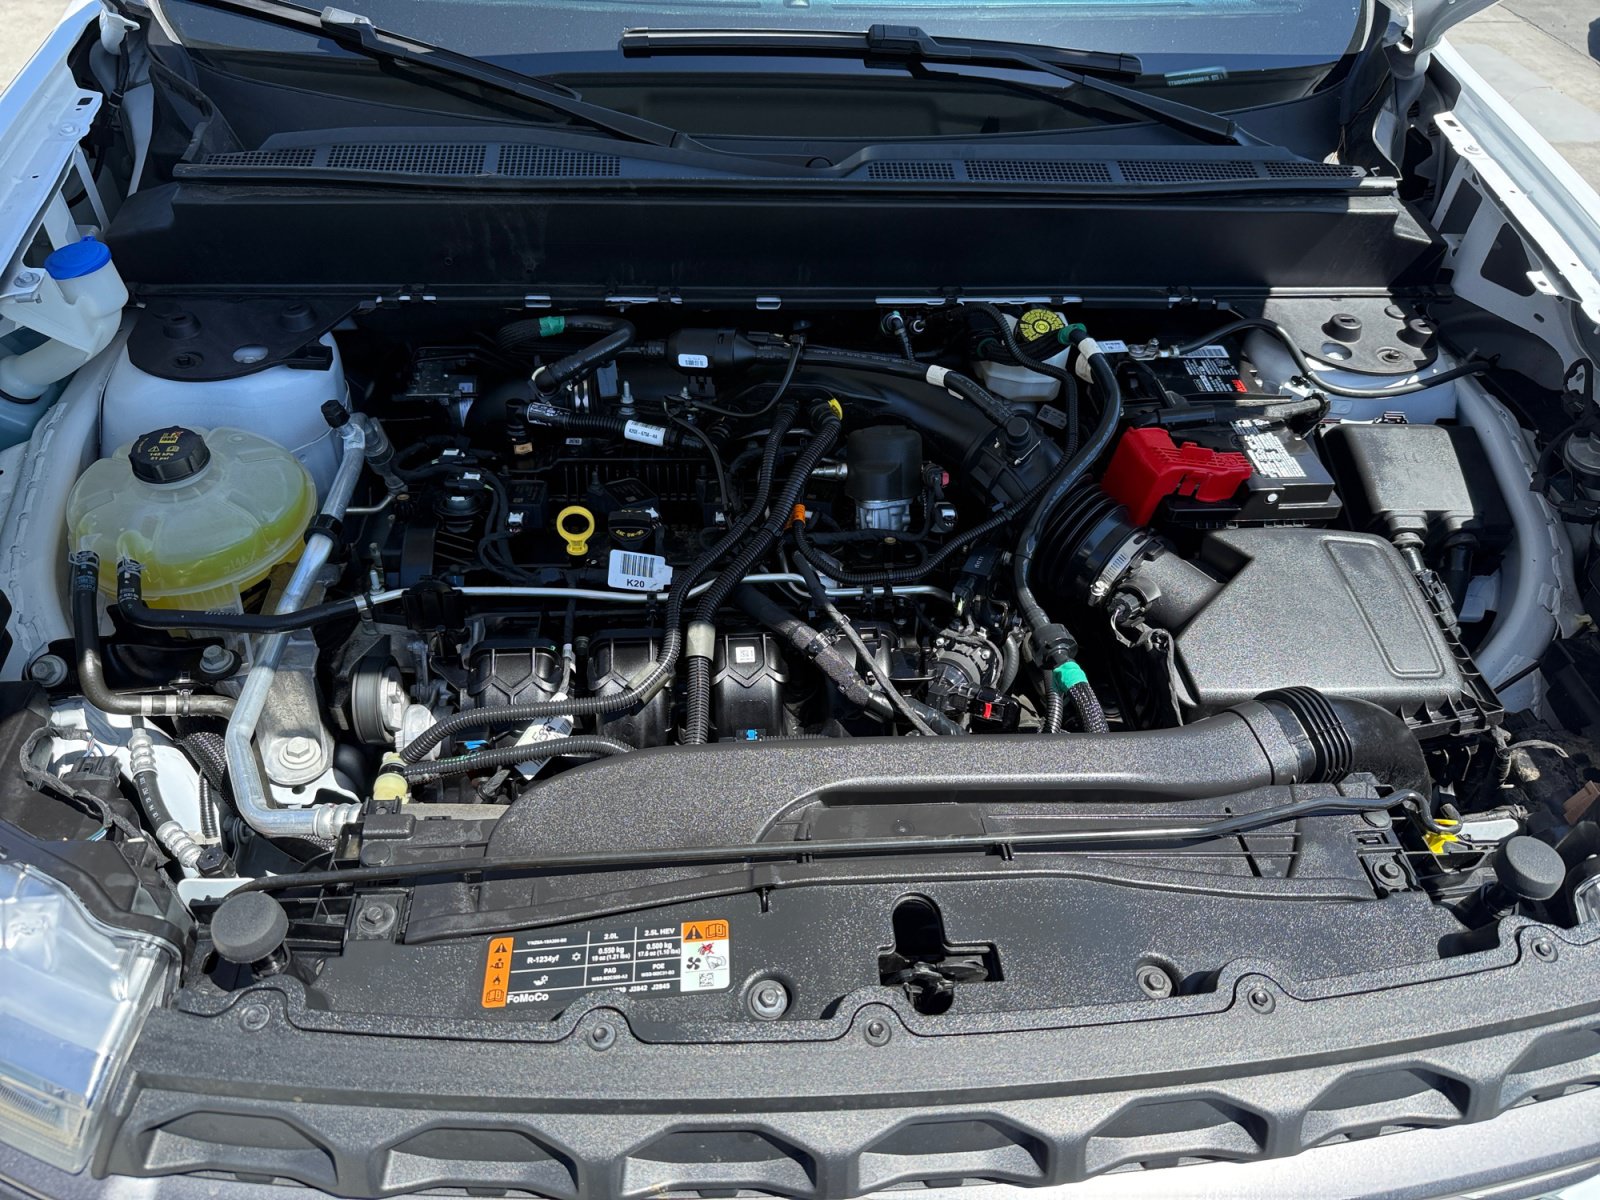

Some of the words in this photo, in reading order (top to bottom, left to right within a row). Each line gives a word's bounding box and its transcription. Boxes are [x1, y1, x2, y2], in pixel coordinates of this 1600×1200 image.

[626, 578, 645, 588] K20
[526, 955, 560, 964] R-1234yf
[507, 993, 549, 1004] FoMoCo
